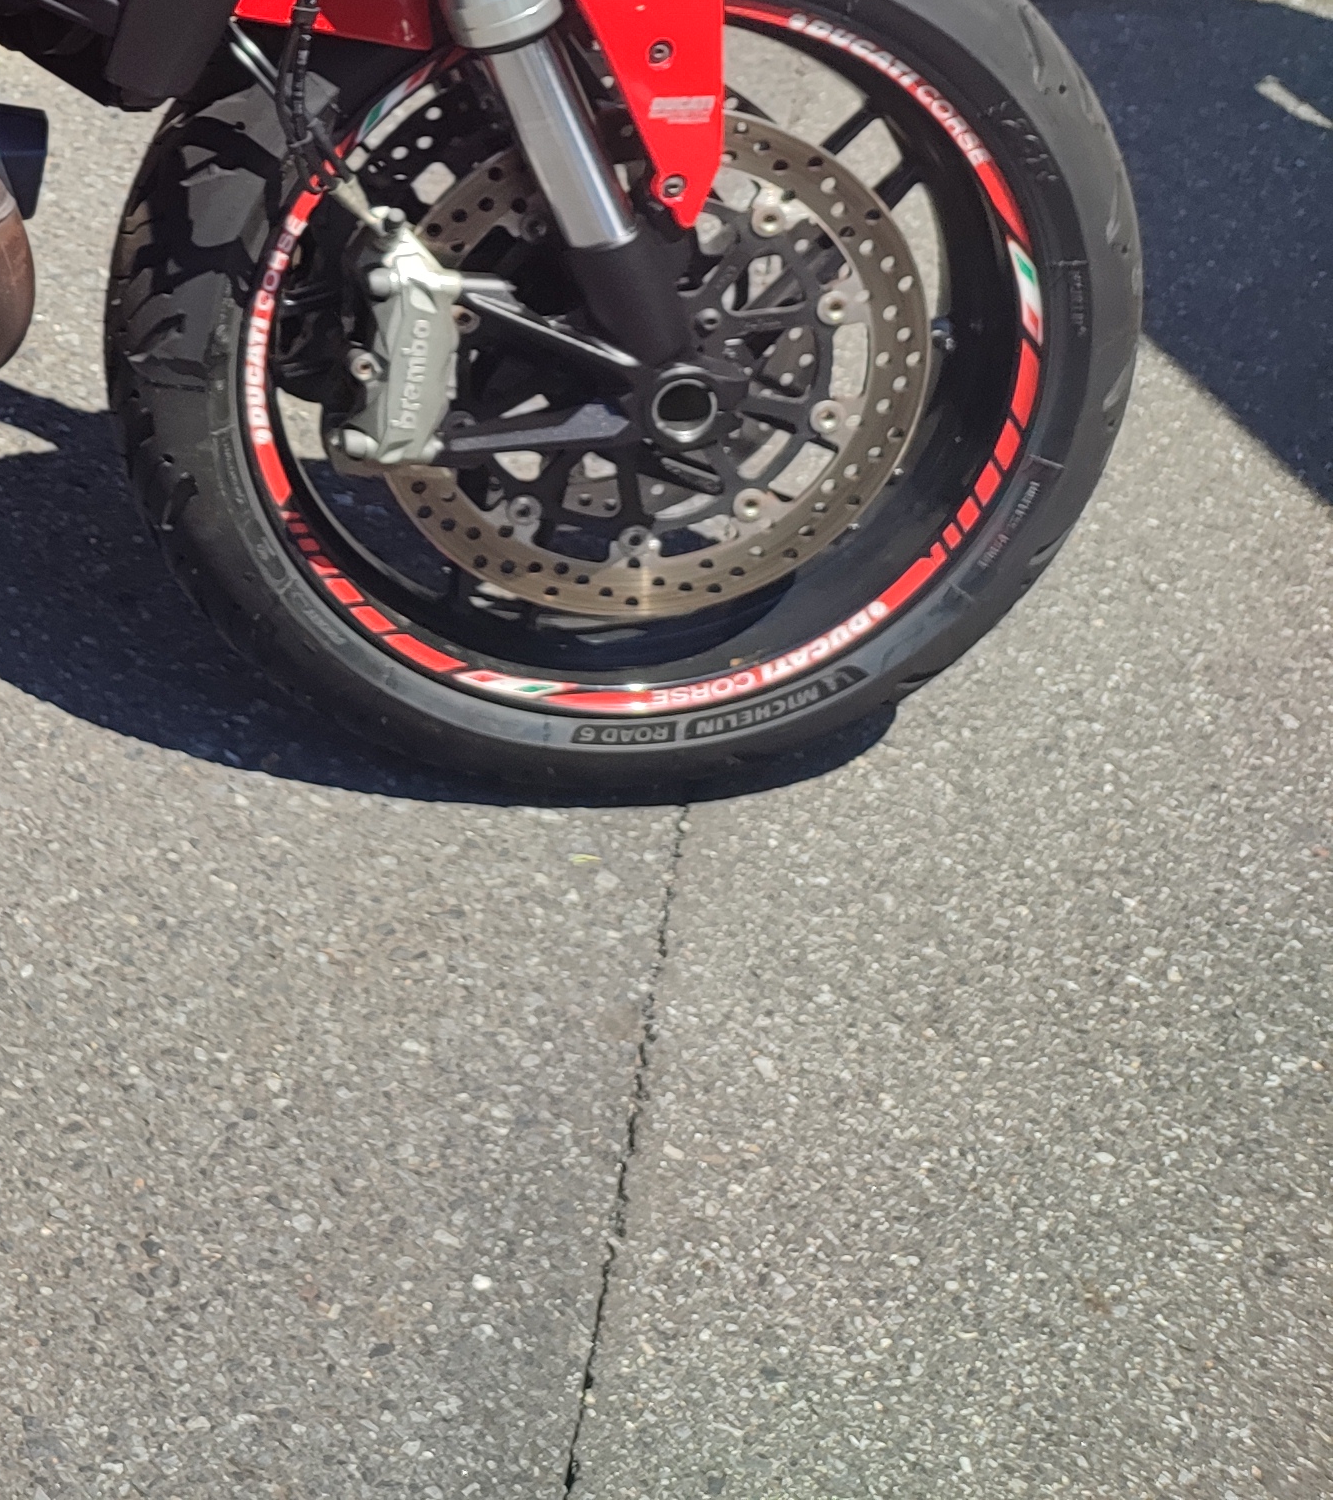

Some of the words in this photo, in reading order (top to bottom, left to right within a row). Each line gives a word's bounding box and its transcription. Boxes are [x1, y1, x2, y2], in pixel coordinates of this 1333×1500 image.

[804, 20, 921, 87] DUCATI
[916, 84, 992, 166] CORSE
[245, 316, 271, 430] DUCATI
[389, 319, 432, 430] brembo
[762, 611, 873, 678] DUCATI
[652, 672, 757, 705] CORSE
[696, 686, 819, 736] MICHELIN
[579, 727, 595, 742] 6
[601, 725, 669, 743] ROAD
